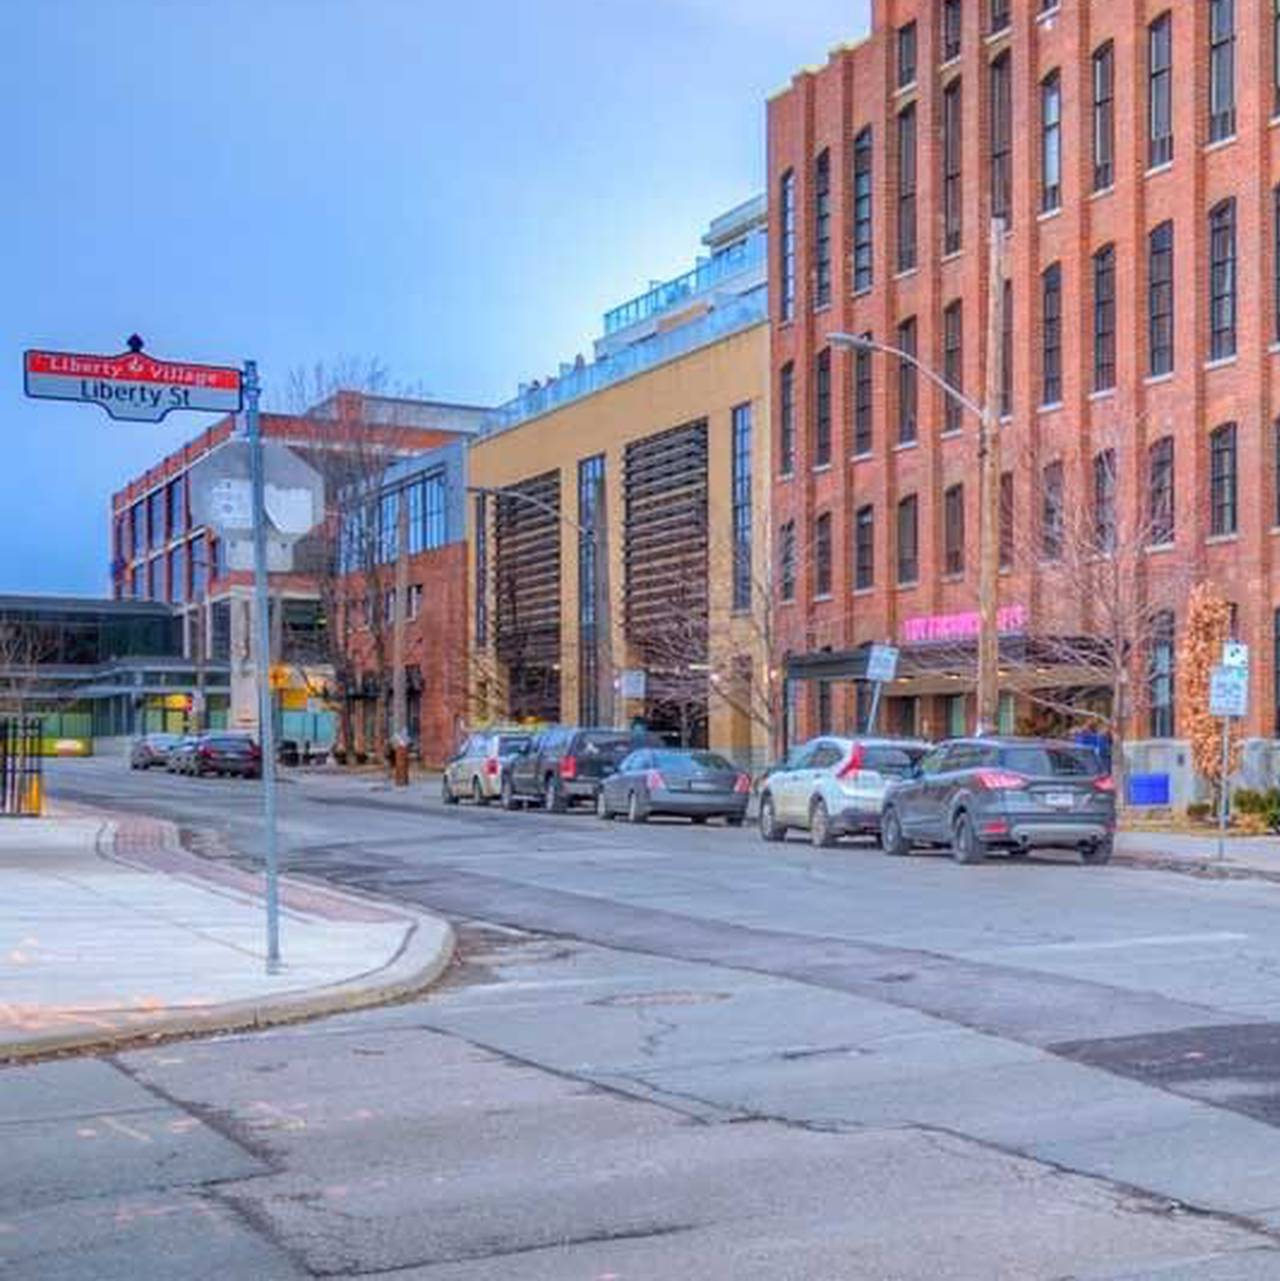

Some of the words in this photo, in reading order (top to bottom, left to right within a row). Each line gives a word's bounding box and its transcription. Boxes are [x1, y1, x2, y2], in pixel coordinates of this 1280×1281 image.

[50, 355, 122, 378] Liberty
[151, 365, 217, 385] Village
[81, 379, 162, 406] Liberty
[169, 386, 190, 406] St
